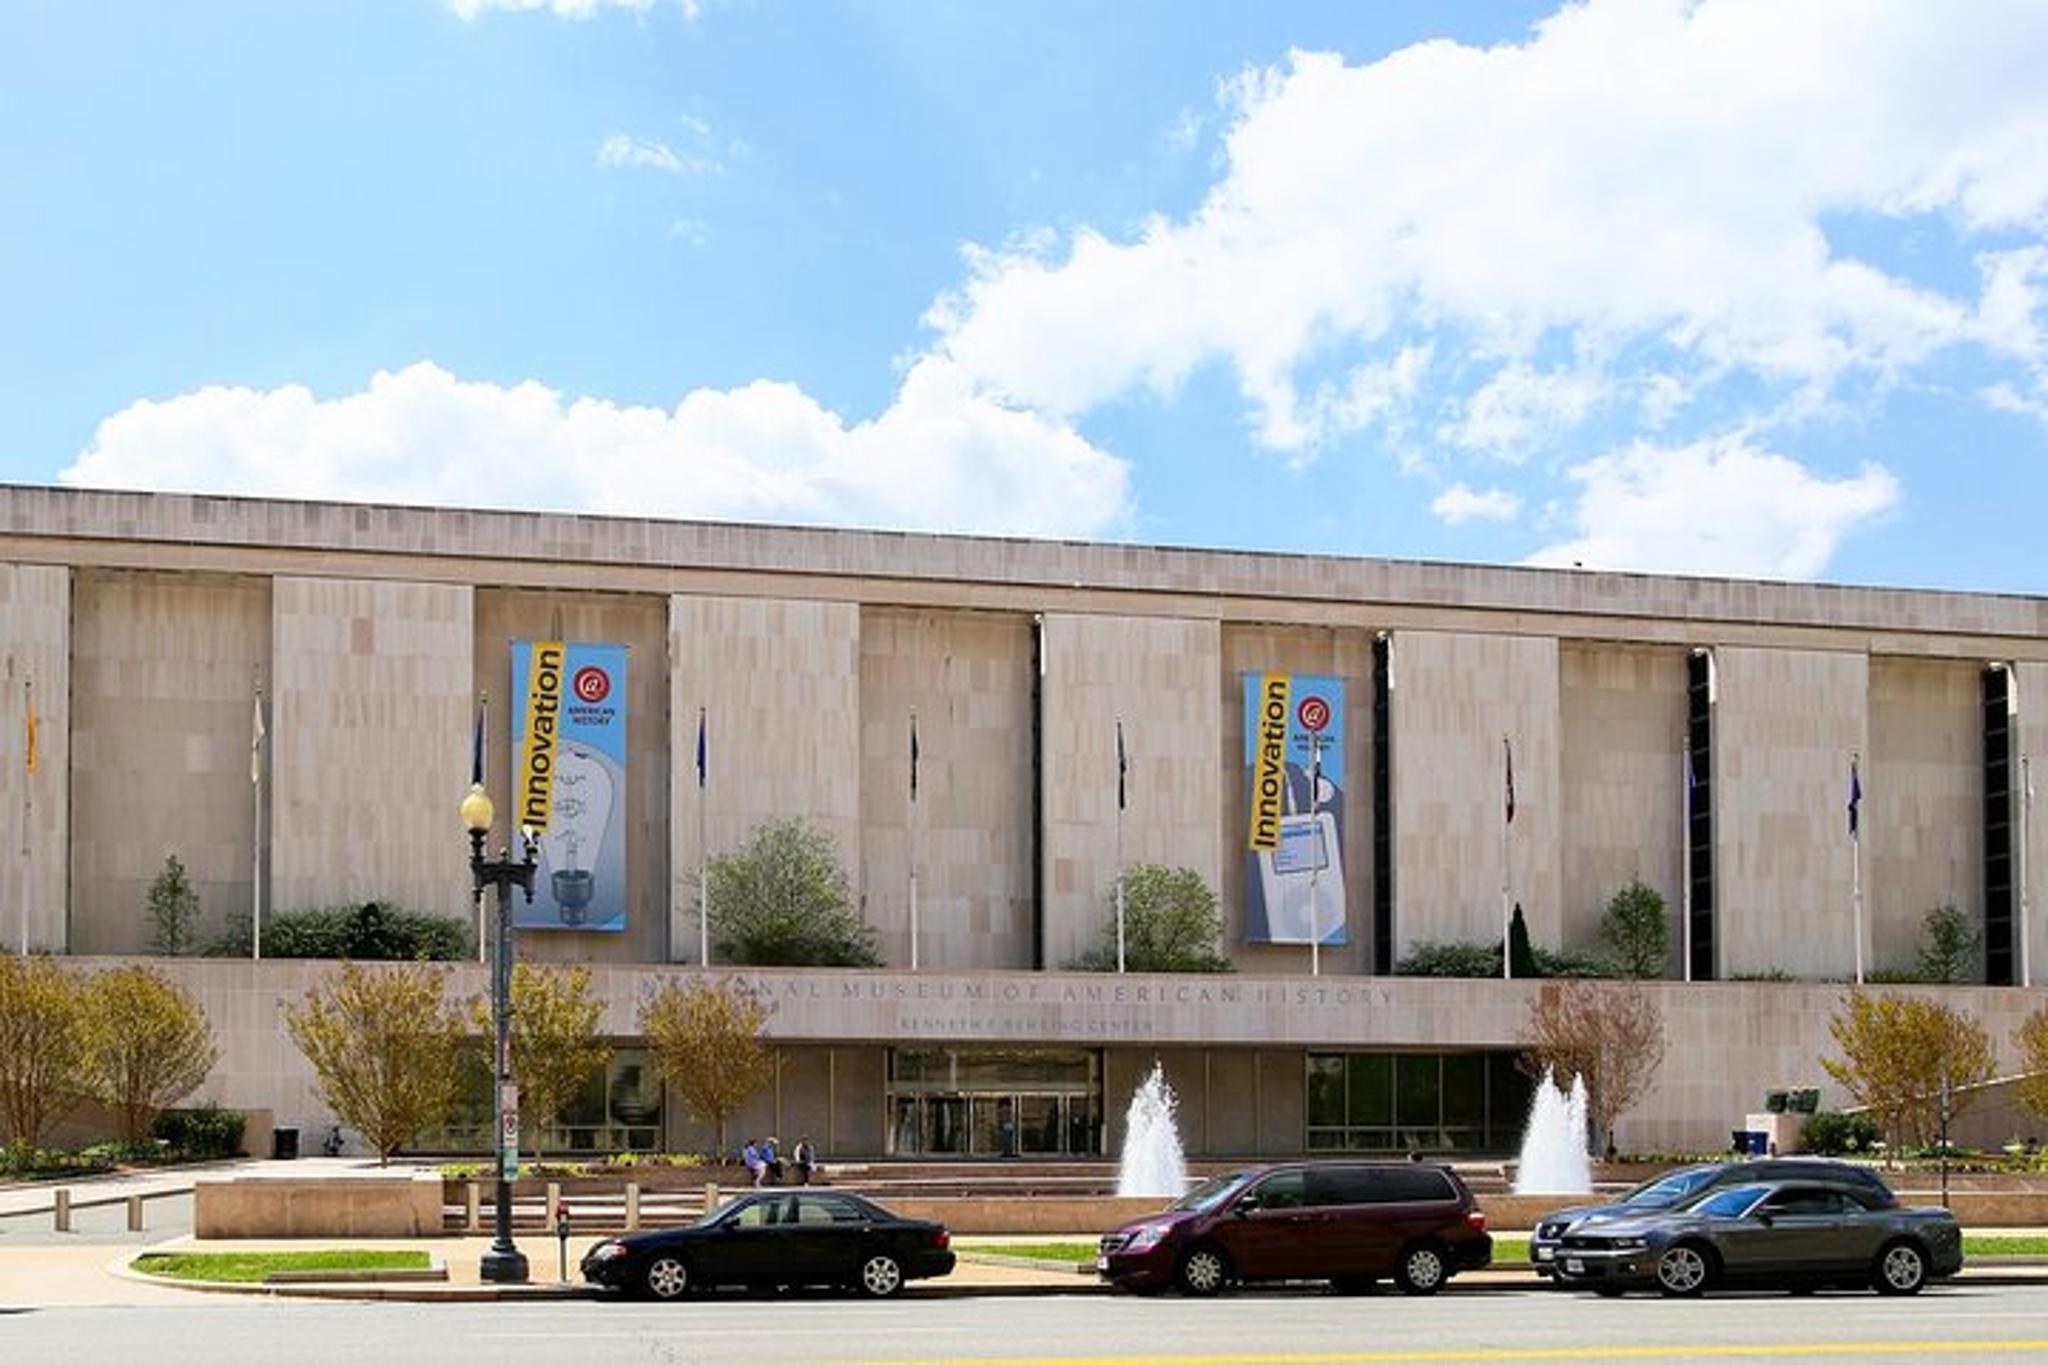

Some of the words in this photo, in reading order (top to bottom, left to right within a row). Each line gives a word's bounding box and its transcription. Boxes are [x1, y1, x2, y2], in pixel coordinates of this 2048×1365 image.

[568, 707, 615, 716] AMERICAN
[573, 716, 610, 726] HISTORY
[522, 650, 560, 828] Innovation
[1254, 681, 1286, 847] Innovation
[843, 982, 983, 1000] MUSEUM
[1004, 985, 1040, 1001] OF
[1063, 985, 1238, 1003] AMERICAN
[1256, 988, 1392, 1005] HISTORY
